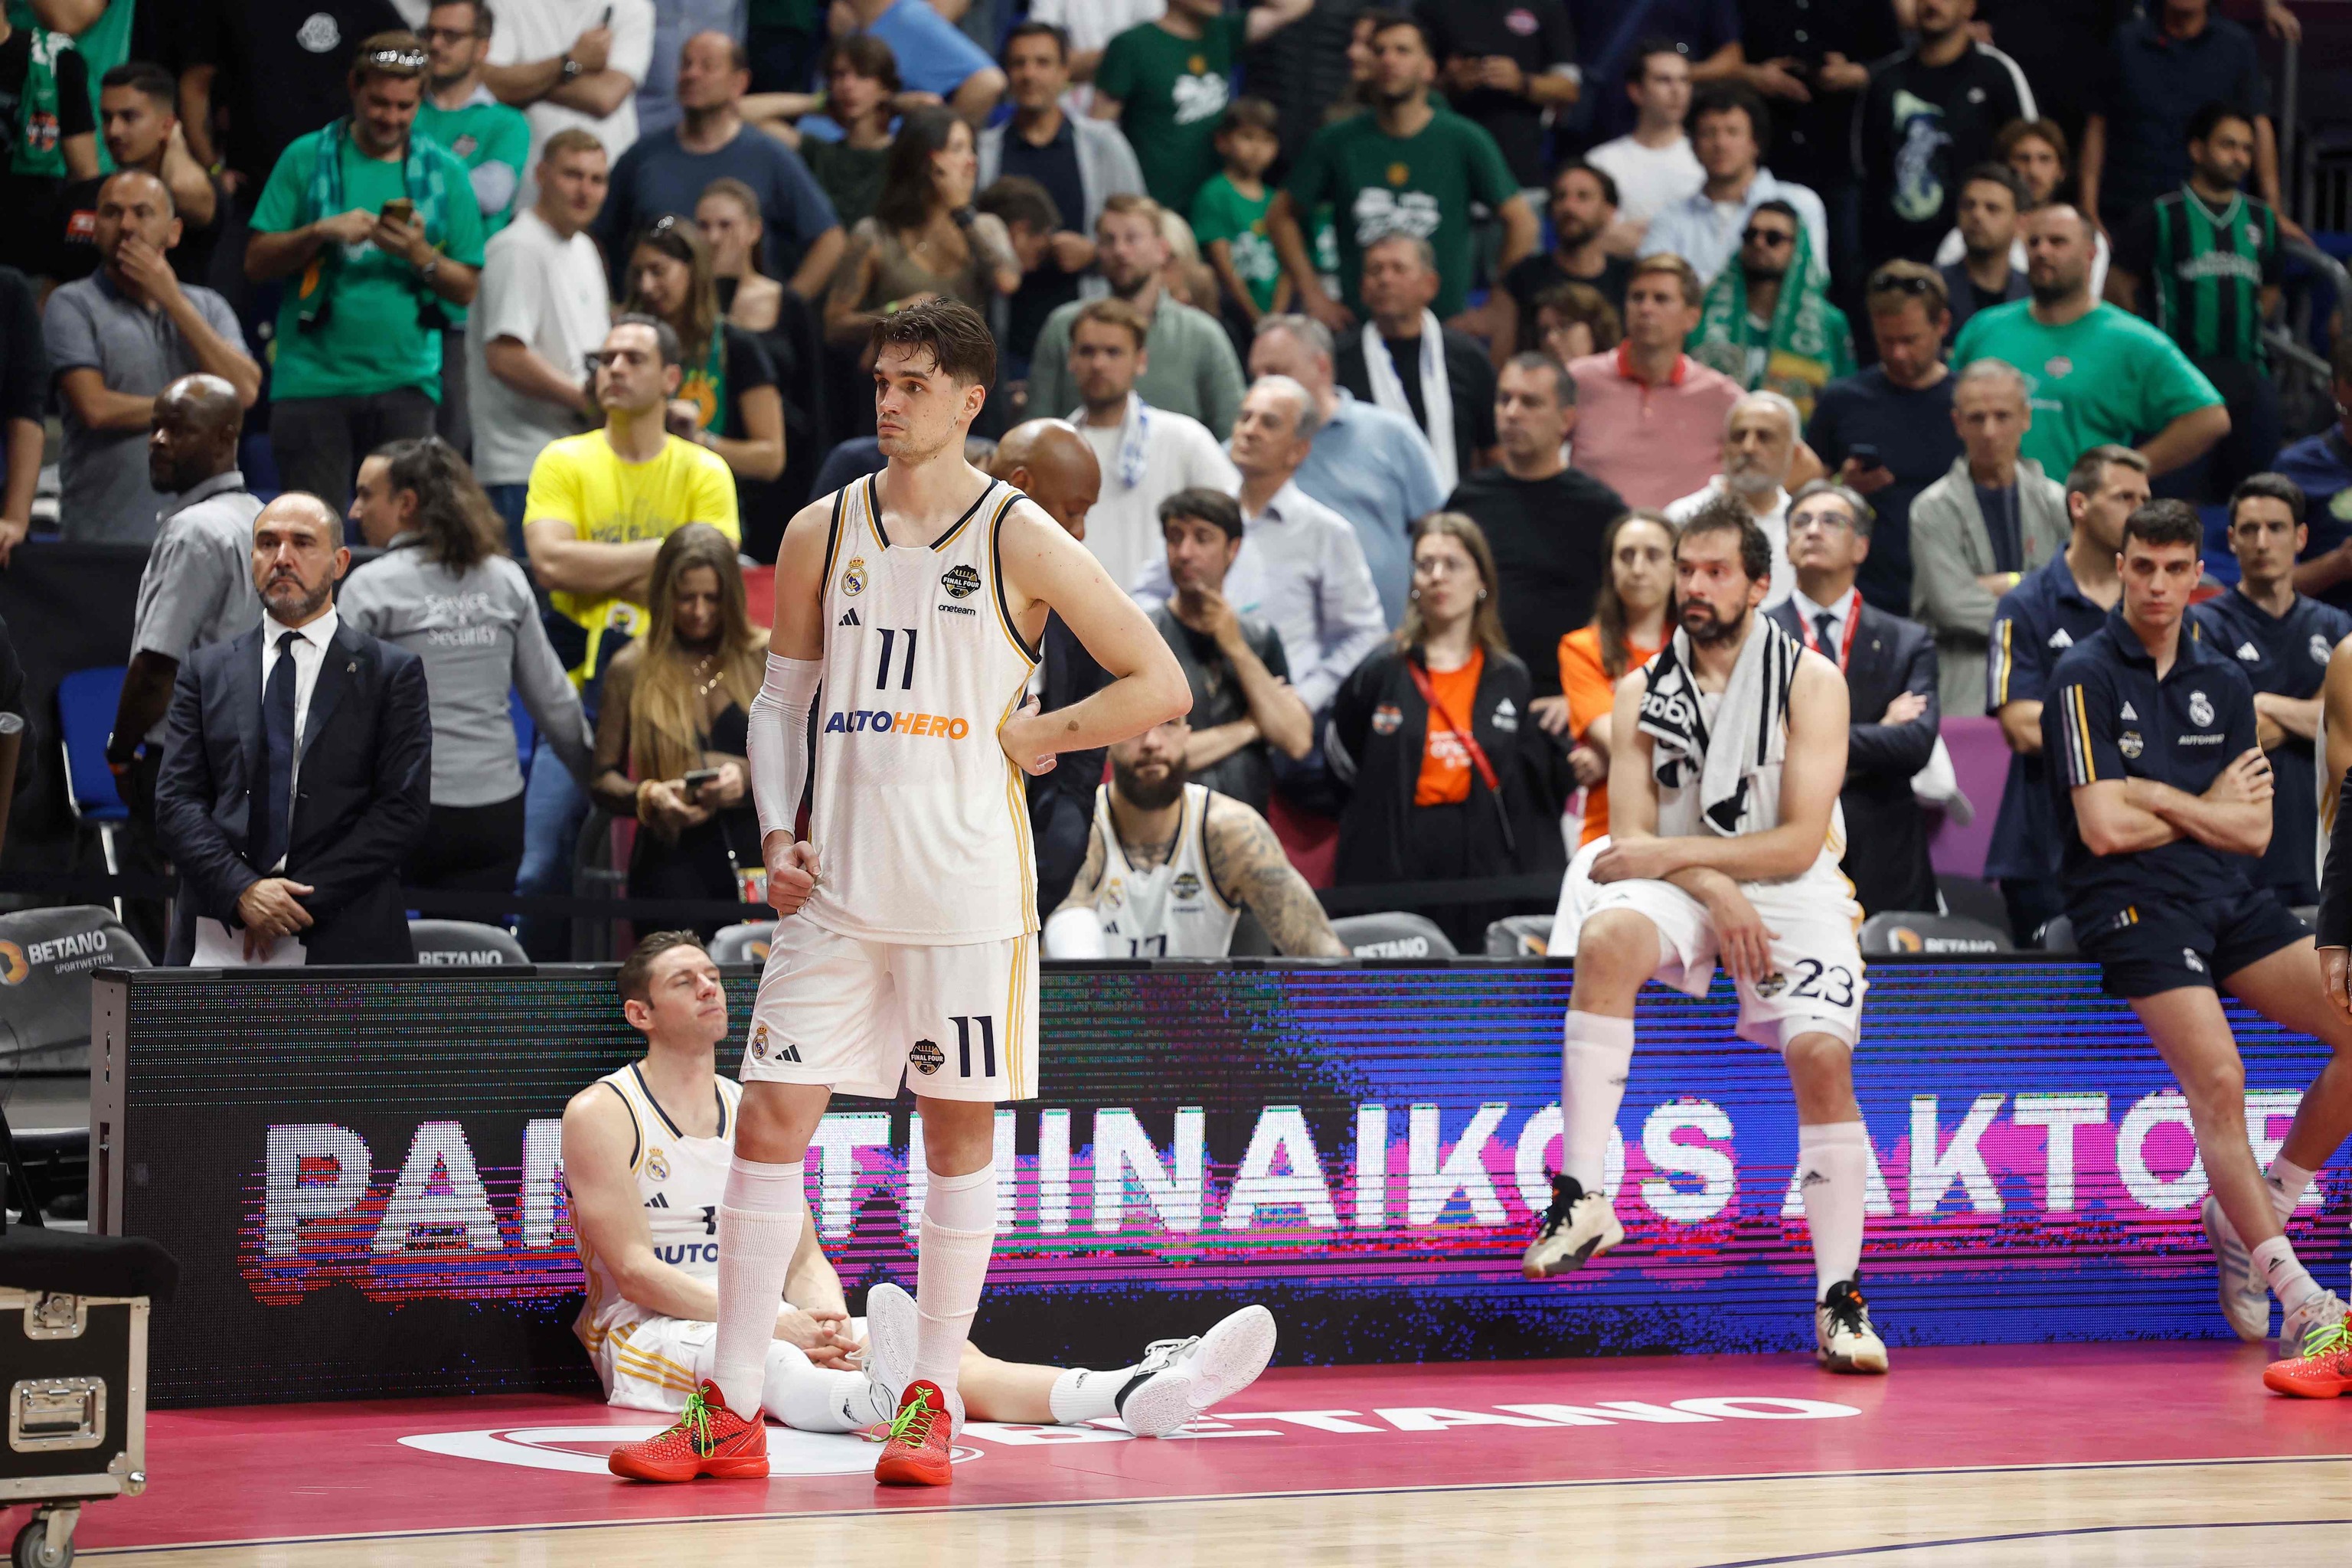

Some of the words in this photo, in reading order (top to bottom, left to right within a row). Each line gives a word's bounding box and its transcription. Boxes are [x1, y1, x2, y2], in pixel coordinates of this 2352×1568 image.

[942, 577, 962, 586] FINAL
[424, 592, 489, 614] Service
[938, 604, 976, 616] oneteam
[426, 625, 498, 646] Security
[876, 628, 918, 690] 11
[824, 710, 969, 740] AUTOHERO
[27, 929, 108, 966] BETANO
[417, 949, 504, 965] BETANO
[54, 952, 114, 975] SPORTWETTEN
[1788, 959, 1854, 1008] 23
[948, 1015, 997, 1078] 11
[265, 1096, 1736, 1258] PATHINAIKOS
